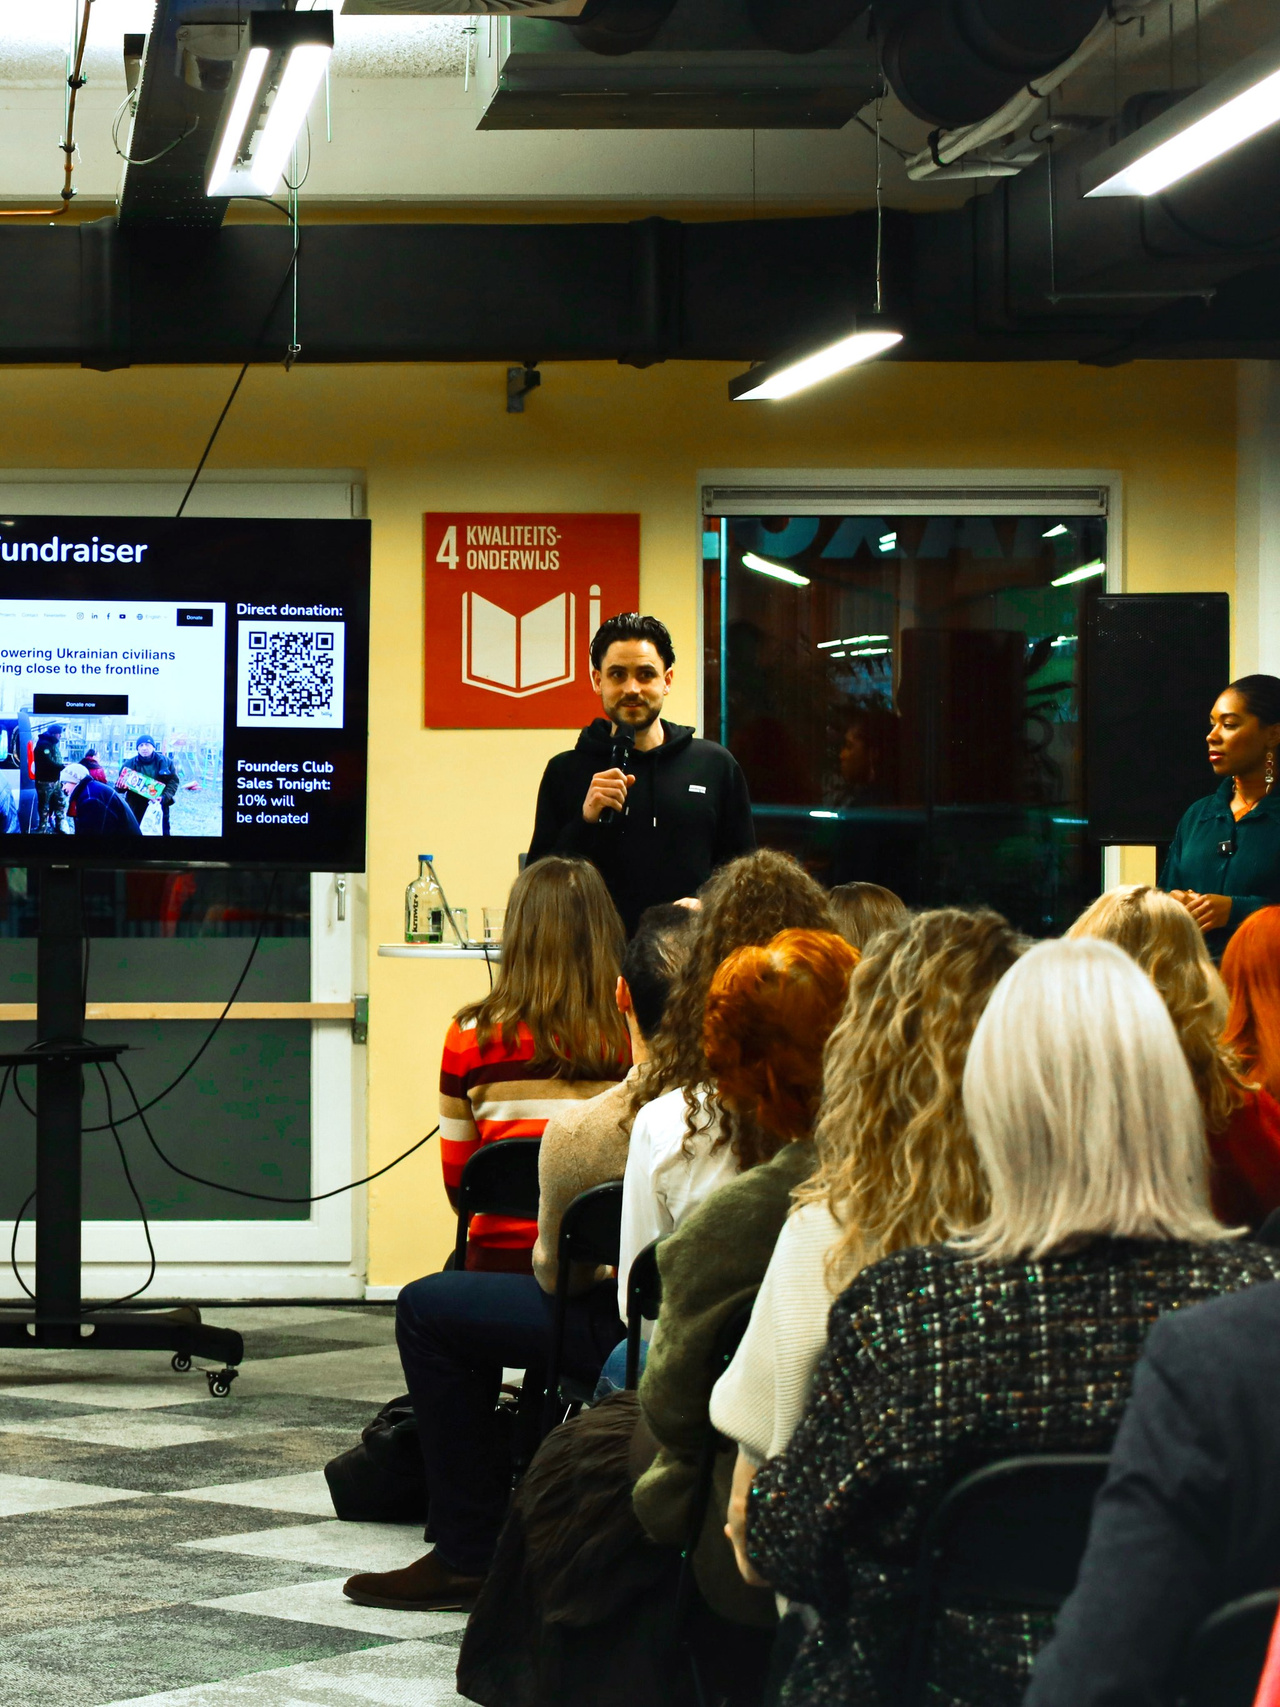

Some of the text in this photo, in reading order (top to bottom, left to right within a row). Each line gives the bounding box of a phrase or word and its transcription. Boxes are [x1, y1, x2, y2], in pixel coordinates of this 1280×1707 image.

[436, 526, 561, 569] 4 KWALITEITS-
[466, 549, 560, 570] ONDERWIJS
[237, 603, 342, 616] Direct donation:
[56, 648, 118, 660] Ukrainian
[122, 648, 175, 660] civilians
[26, 662, 60, 674] close
[65, 663, 77, 674] to
[81, 663, 101, 675] the
[105, 663, 160, 676] frontline
[237, 760, 334, 774] Founders Club
[237, 778, 331, 792] Sales Tonight:
[237, 795, 294, 807] 10% will
[237, 811, 308, 824] be donated
